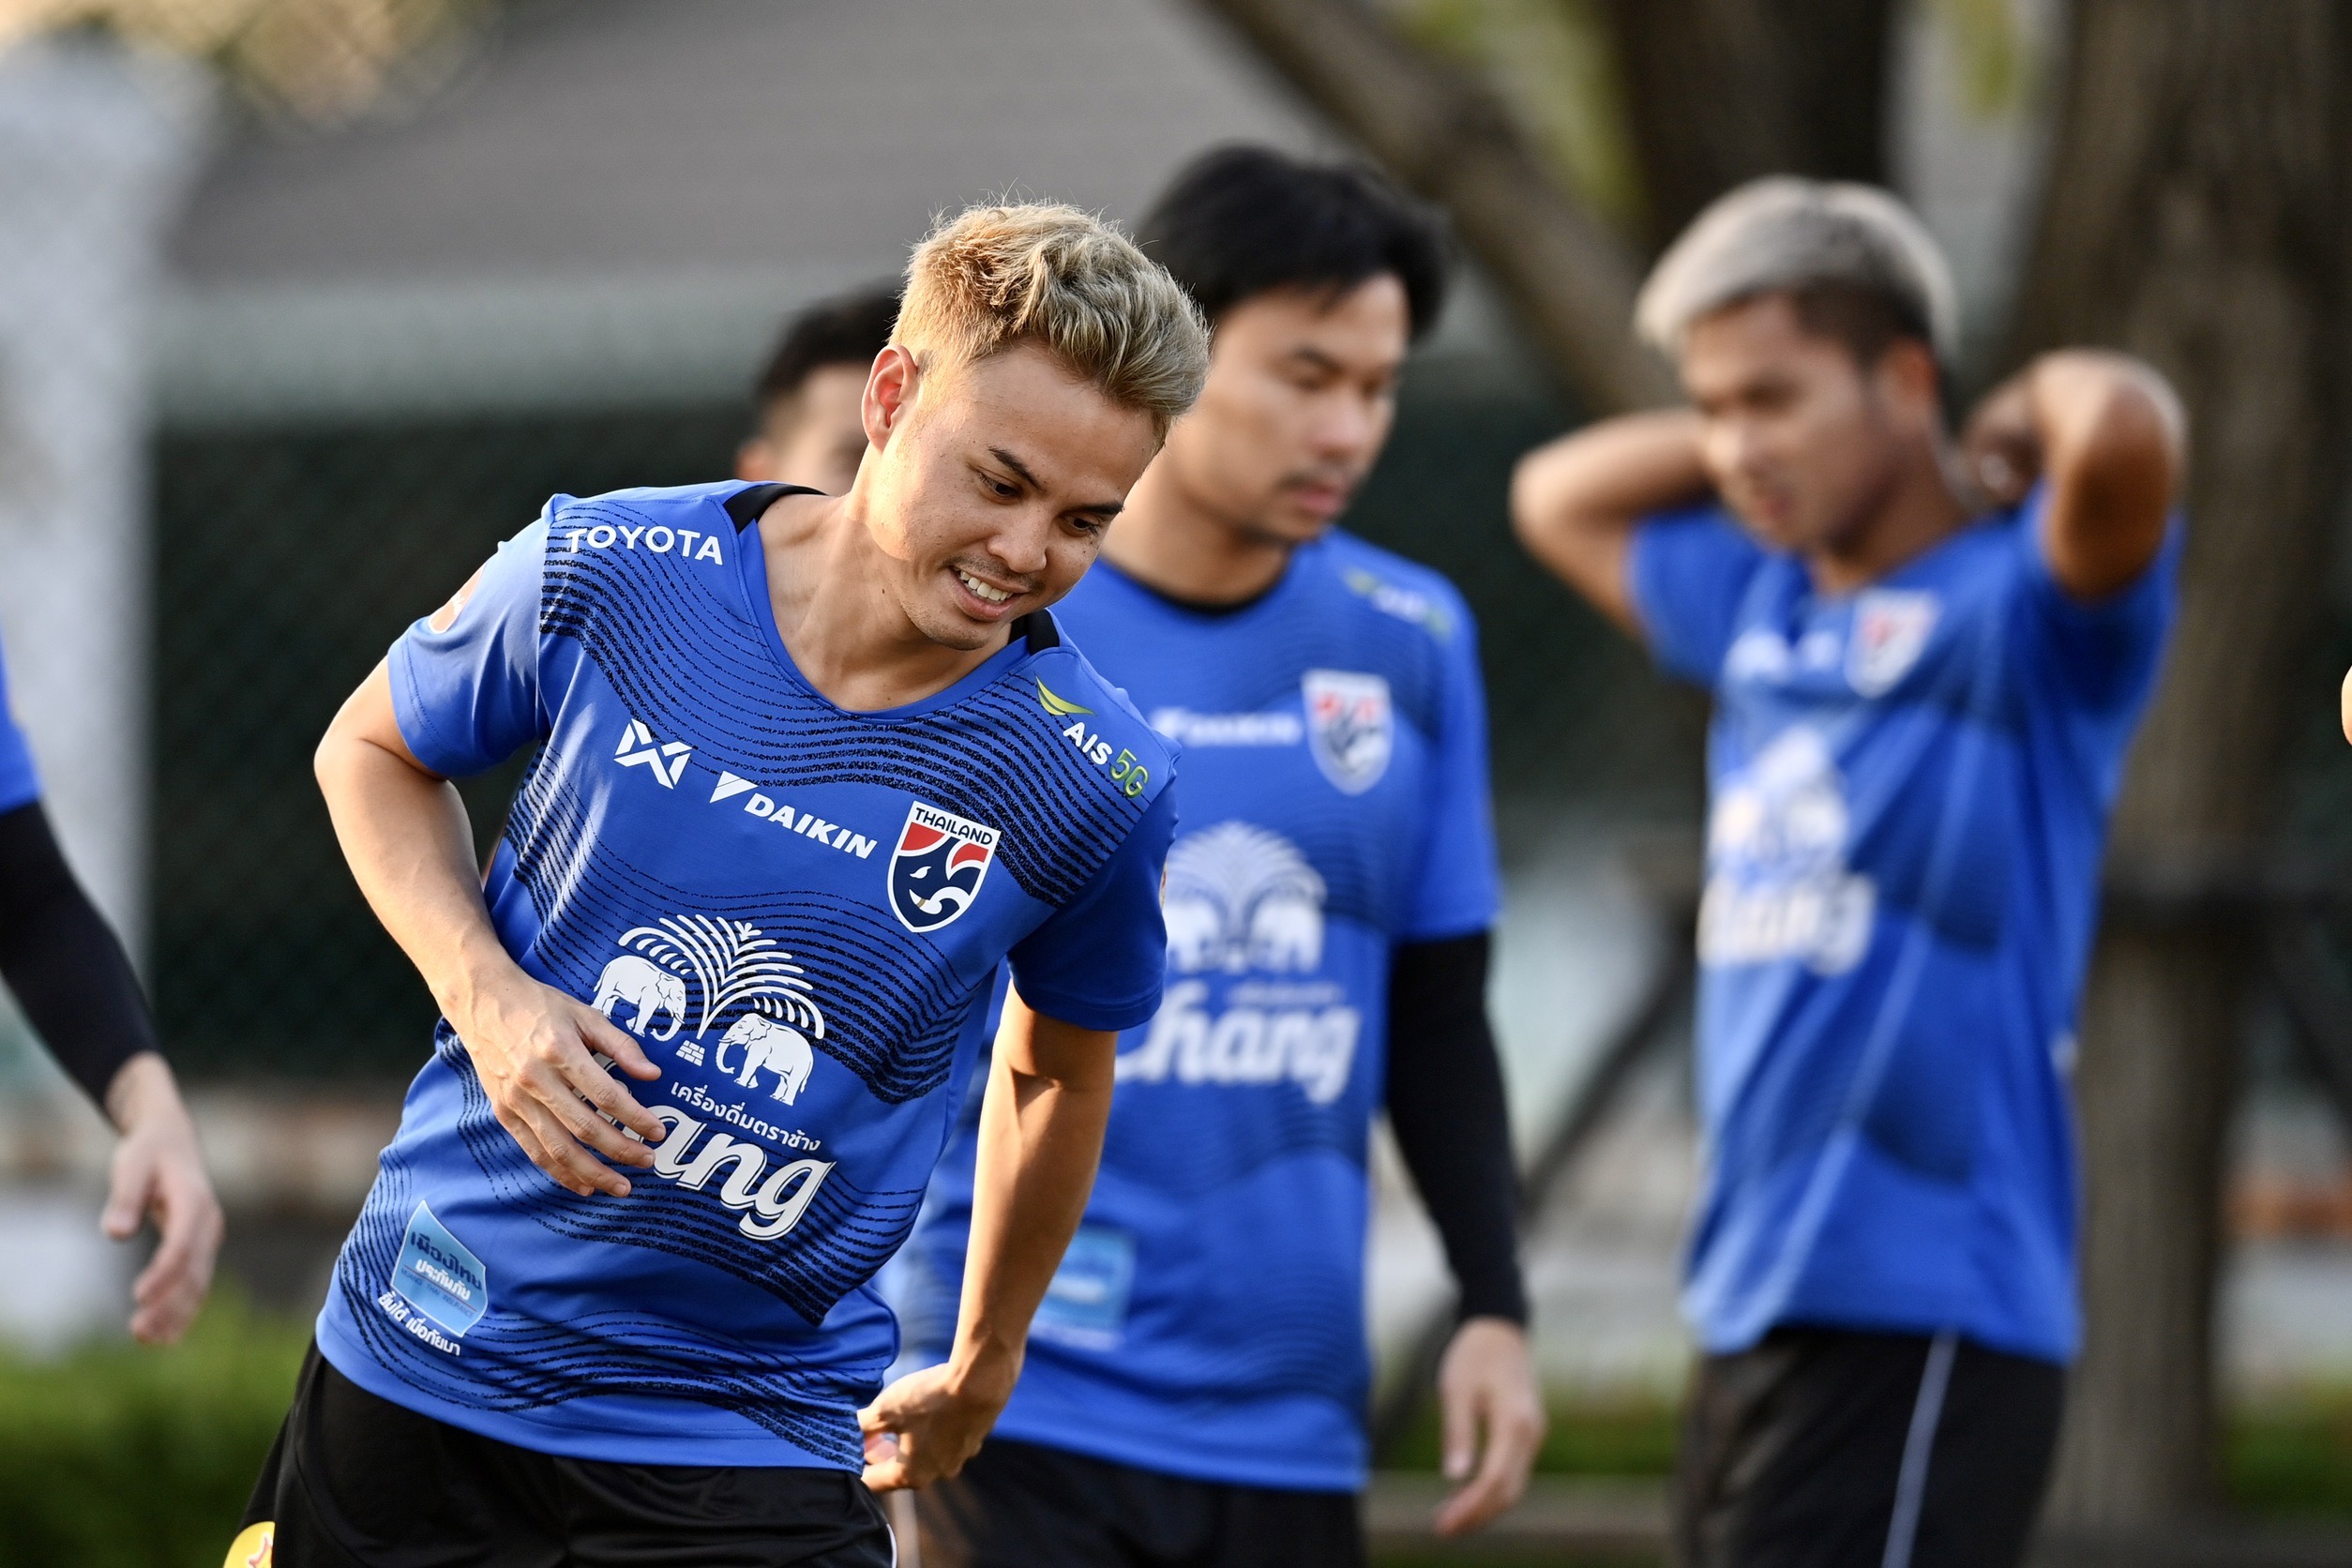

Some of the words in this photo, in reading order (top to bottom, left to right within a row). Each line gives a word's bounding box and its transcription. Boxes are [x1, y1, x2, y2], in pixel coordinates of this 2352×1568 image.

[565, 525, 723, 565] TOYOTA
[1063, 722, 1113, 765] AIS
[1110, 748, 1150, 798] 5G
[744, 792, 879, 860] DAIKIN
[914, 807, 993, 846] THAILAND
[1114, 977, 1362, 1107] hang
[671, 1081, 822, 1152] เครื่องดื่มตราช้าง
[600, 1088, 837, 1242] ang
[415, 1259, 471, 1301] ประกันภัย
[405, 1317, 461, 1356] เมื่อภัยมา
